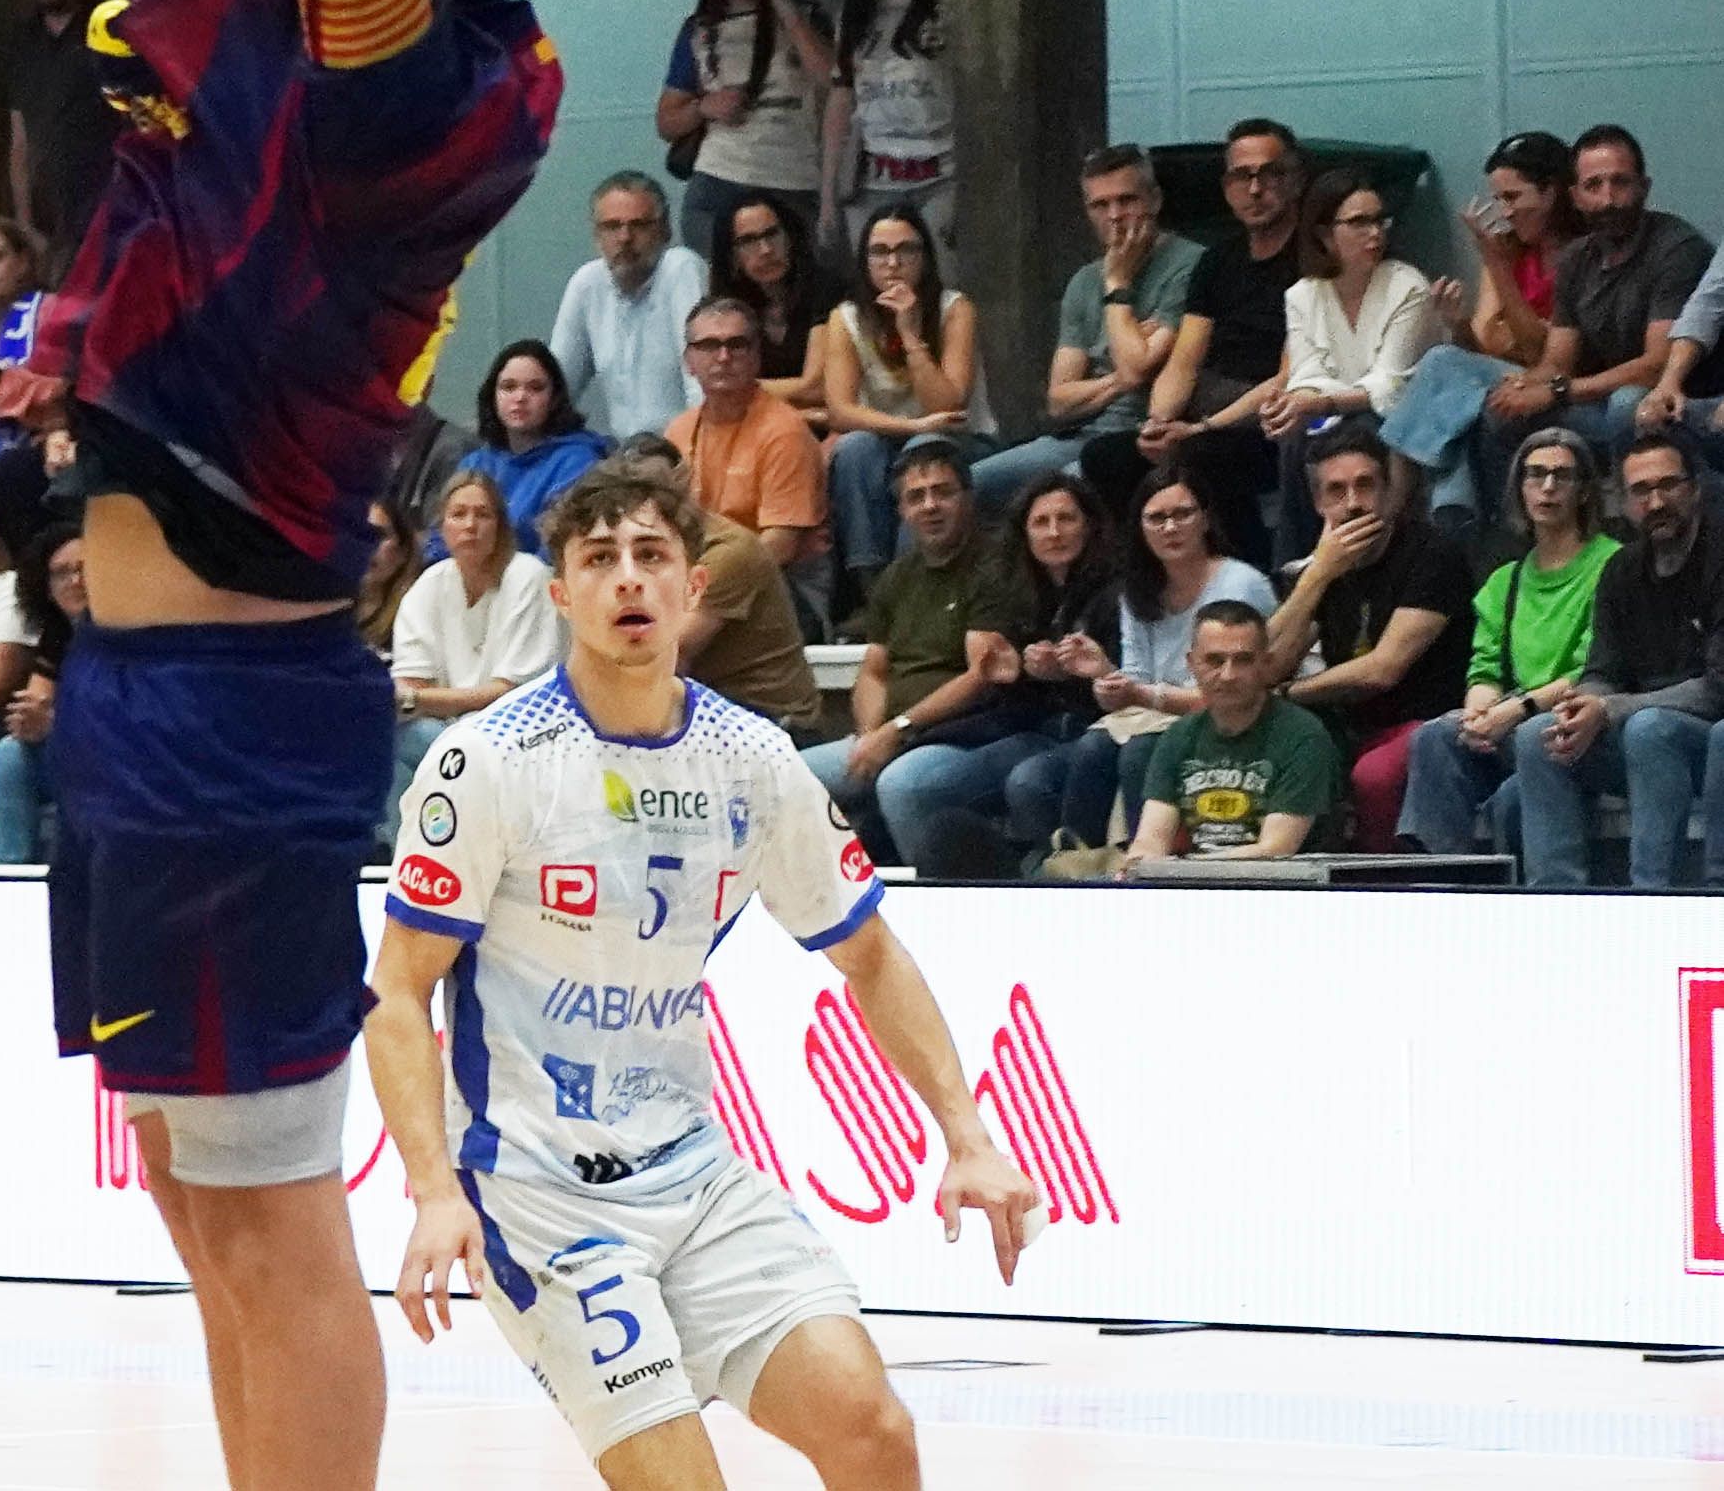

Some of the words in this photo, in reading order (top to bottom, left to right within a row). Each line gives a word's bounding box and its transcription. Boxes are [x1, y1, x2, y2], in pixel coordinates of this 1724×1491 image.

[640, 788, 709, 821] ence
[638, 854, 685, 941] 5
[577, 1274, 641, 1365] 5
[603, 1357, 674, 1394] Kempa
